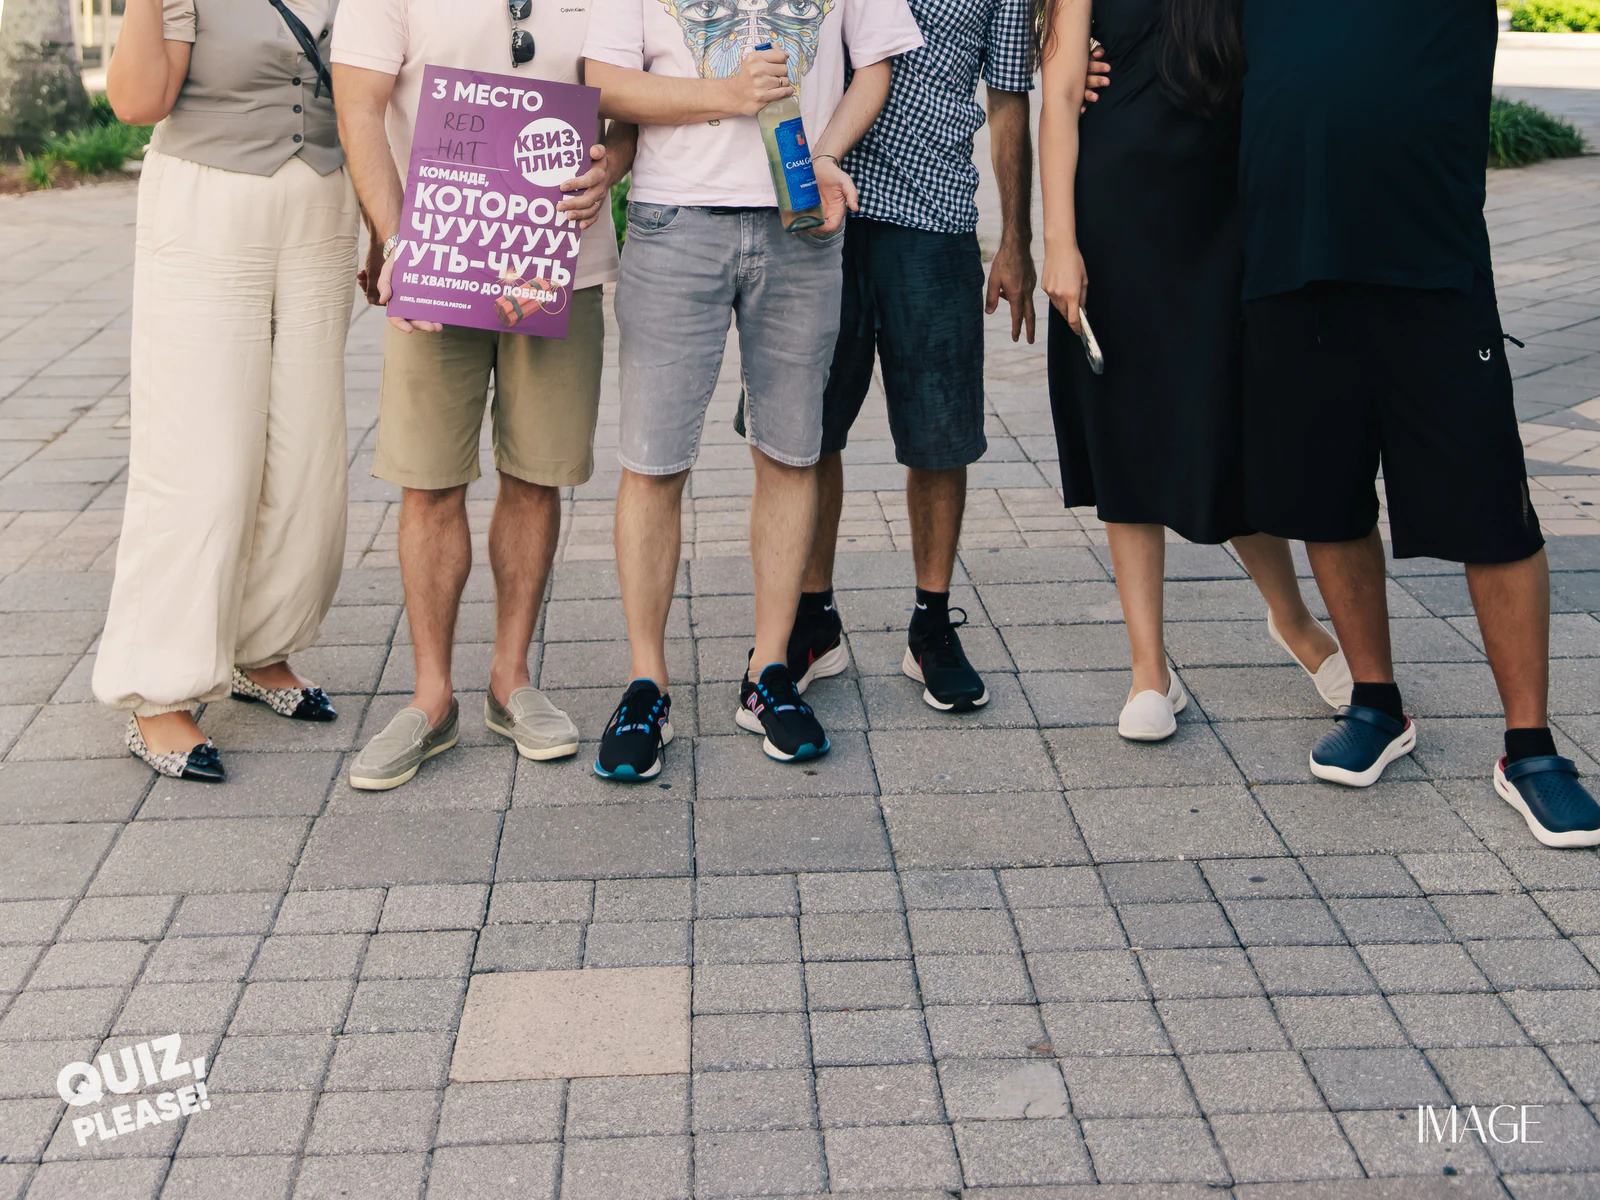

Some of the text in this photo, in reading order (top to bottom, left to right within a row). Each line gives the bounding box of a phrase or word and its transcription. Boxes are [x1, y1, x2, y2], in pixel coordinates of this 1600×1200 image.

[431, 78, 544, 112] 3 МЕСТО
[443, 112, 485, 133] RED
[437, 137, 488, 164] HAT
[516, 128, 582, 154] КВИЗ,
[516, 149, 582, 174] ПЛИЗ!
[418, 165, 490, 188] КОМАНДЕ,
[402, 272, 558, 303] НЕ ХВАТИЛО ДО ПОБЕДЫ
